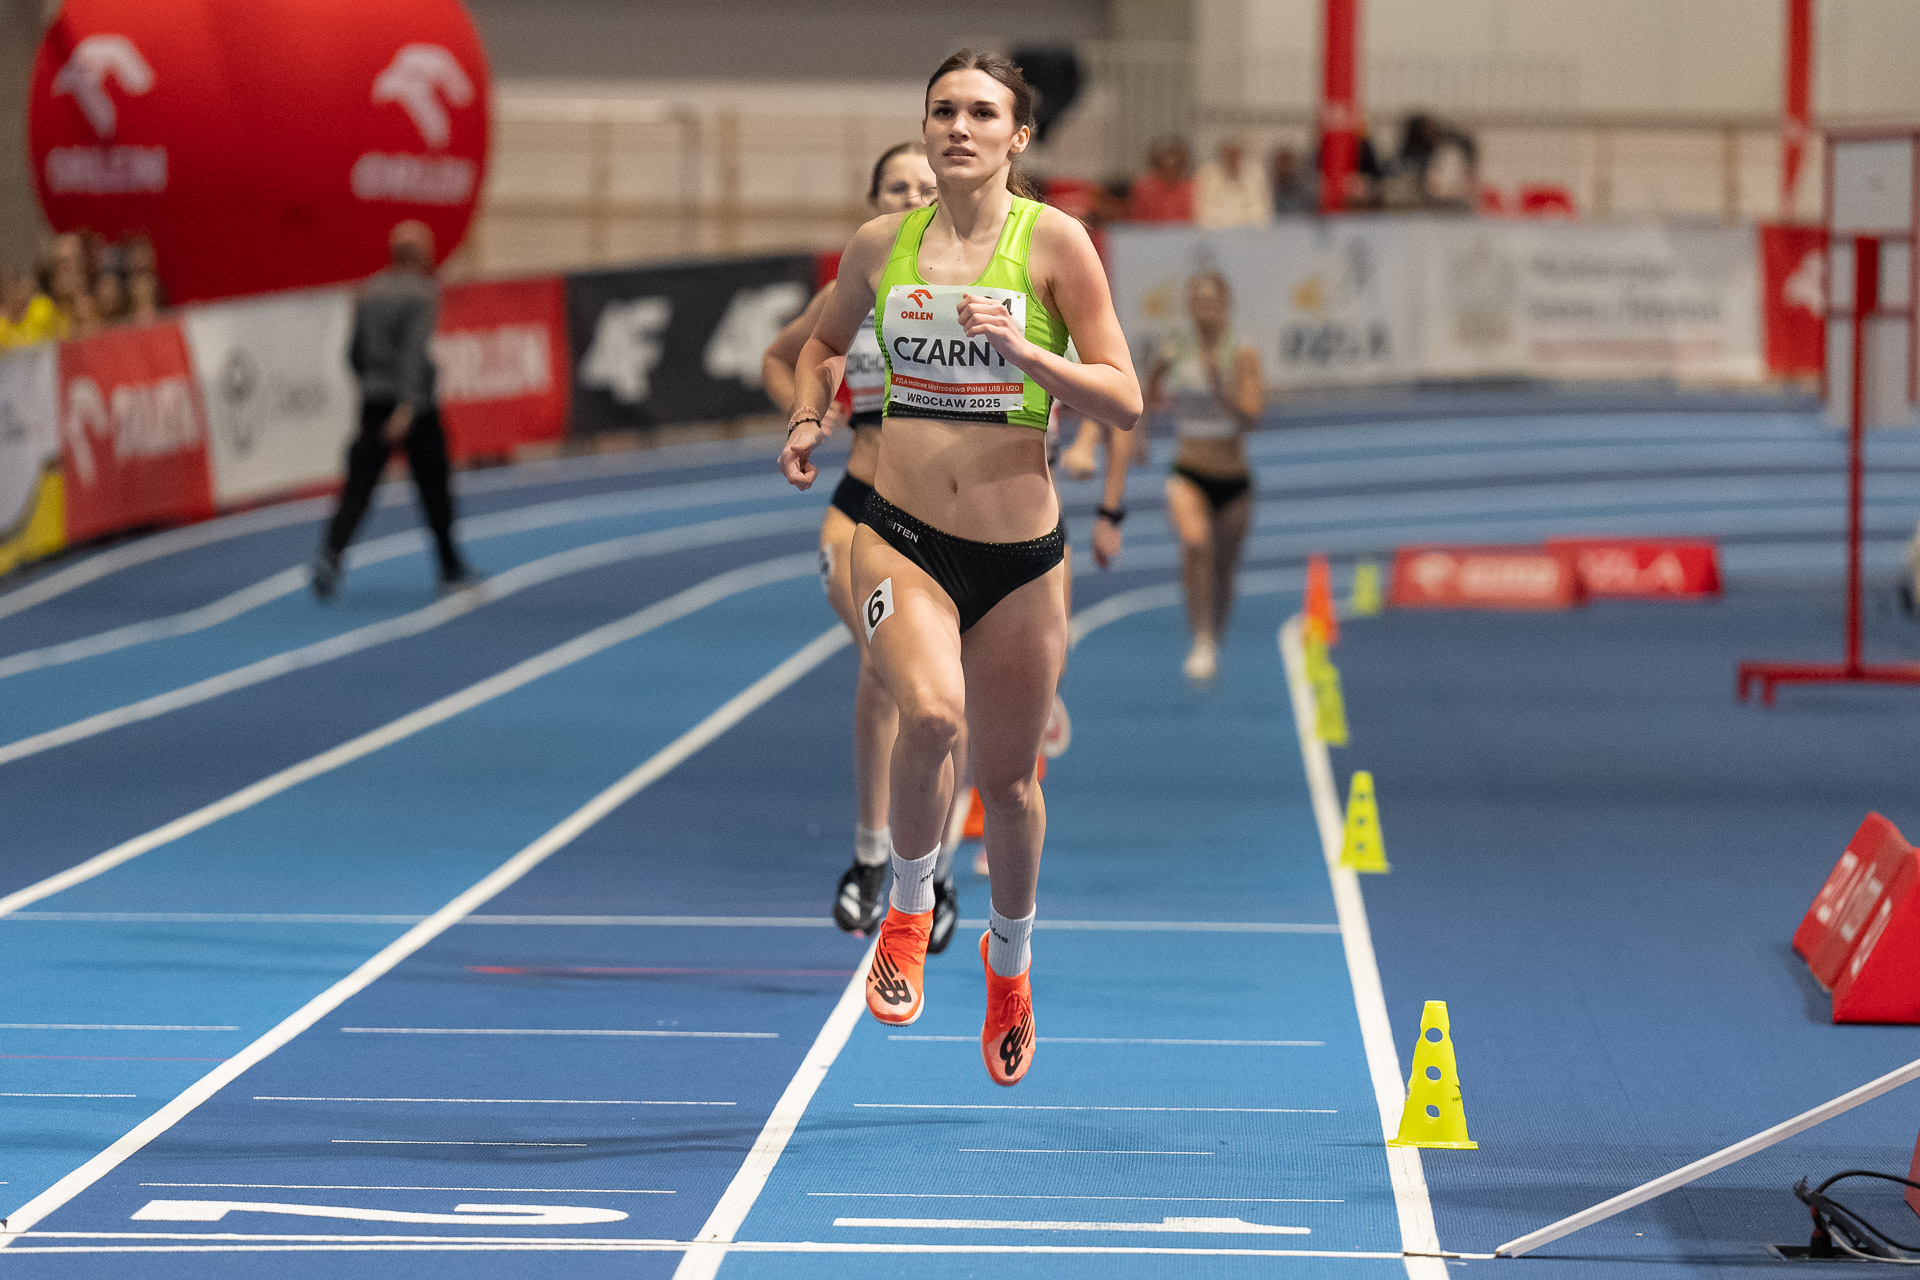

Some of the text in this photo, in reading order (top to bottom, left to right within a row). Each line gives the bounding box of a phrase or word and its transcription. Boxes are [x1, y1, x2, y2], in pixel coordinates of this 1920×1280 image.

[901, 311, 933, 321] ORLEN
[895, 377, 908, 387] PZLA
[908, 380, 927, 390] Halowe
[928, 383, 966, 393] Mistrzostwa
[966, 385, 988, 393] Polski
[907, 392, 1001, 408] WROCŁAW 2025
[867, 589, 885, 629] 6
[130, 1200, 629, 1225] 2
[832, 1216, 1312, 1235] 1
